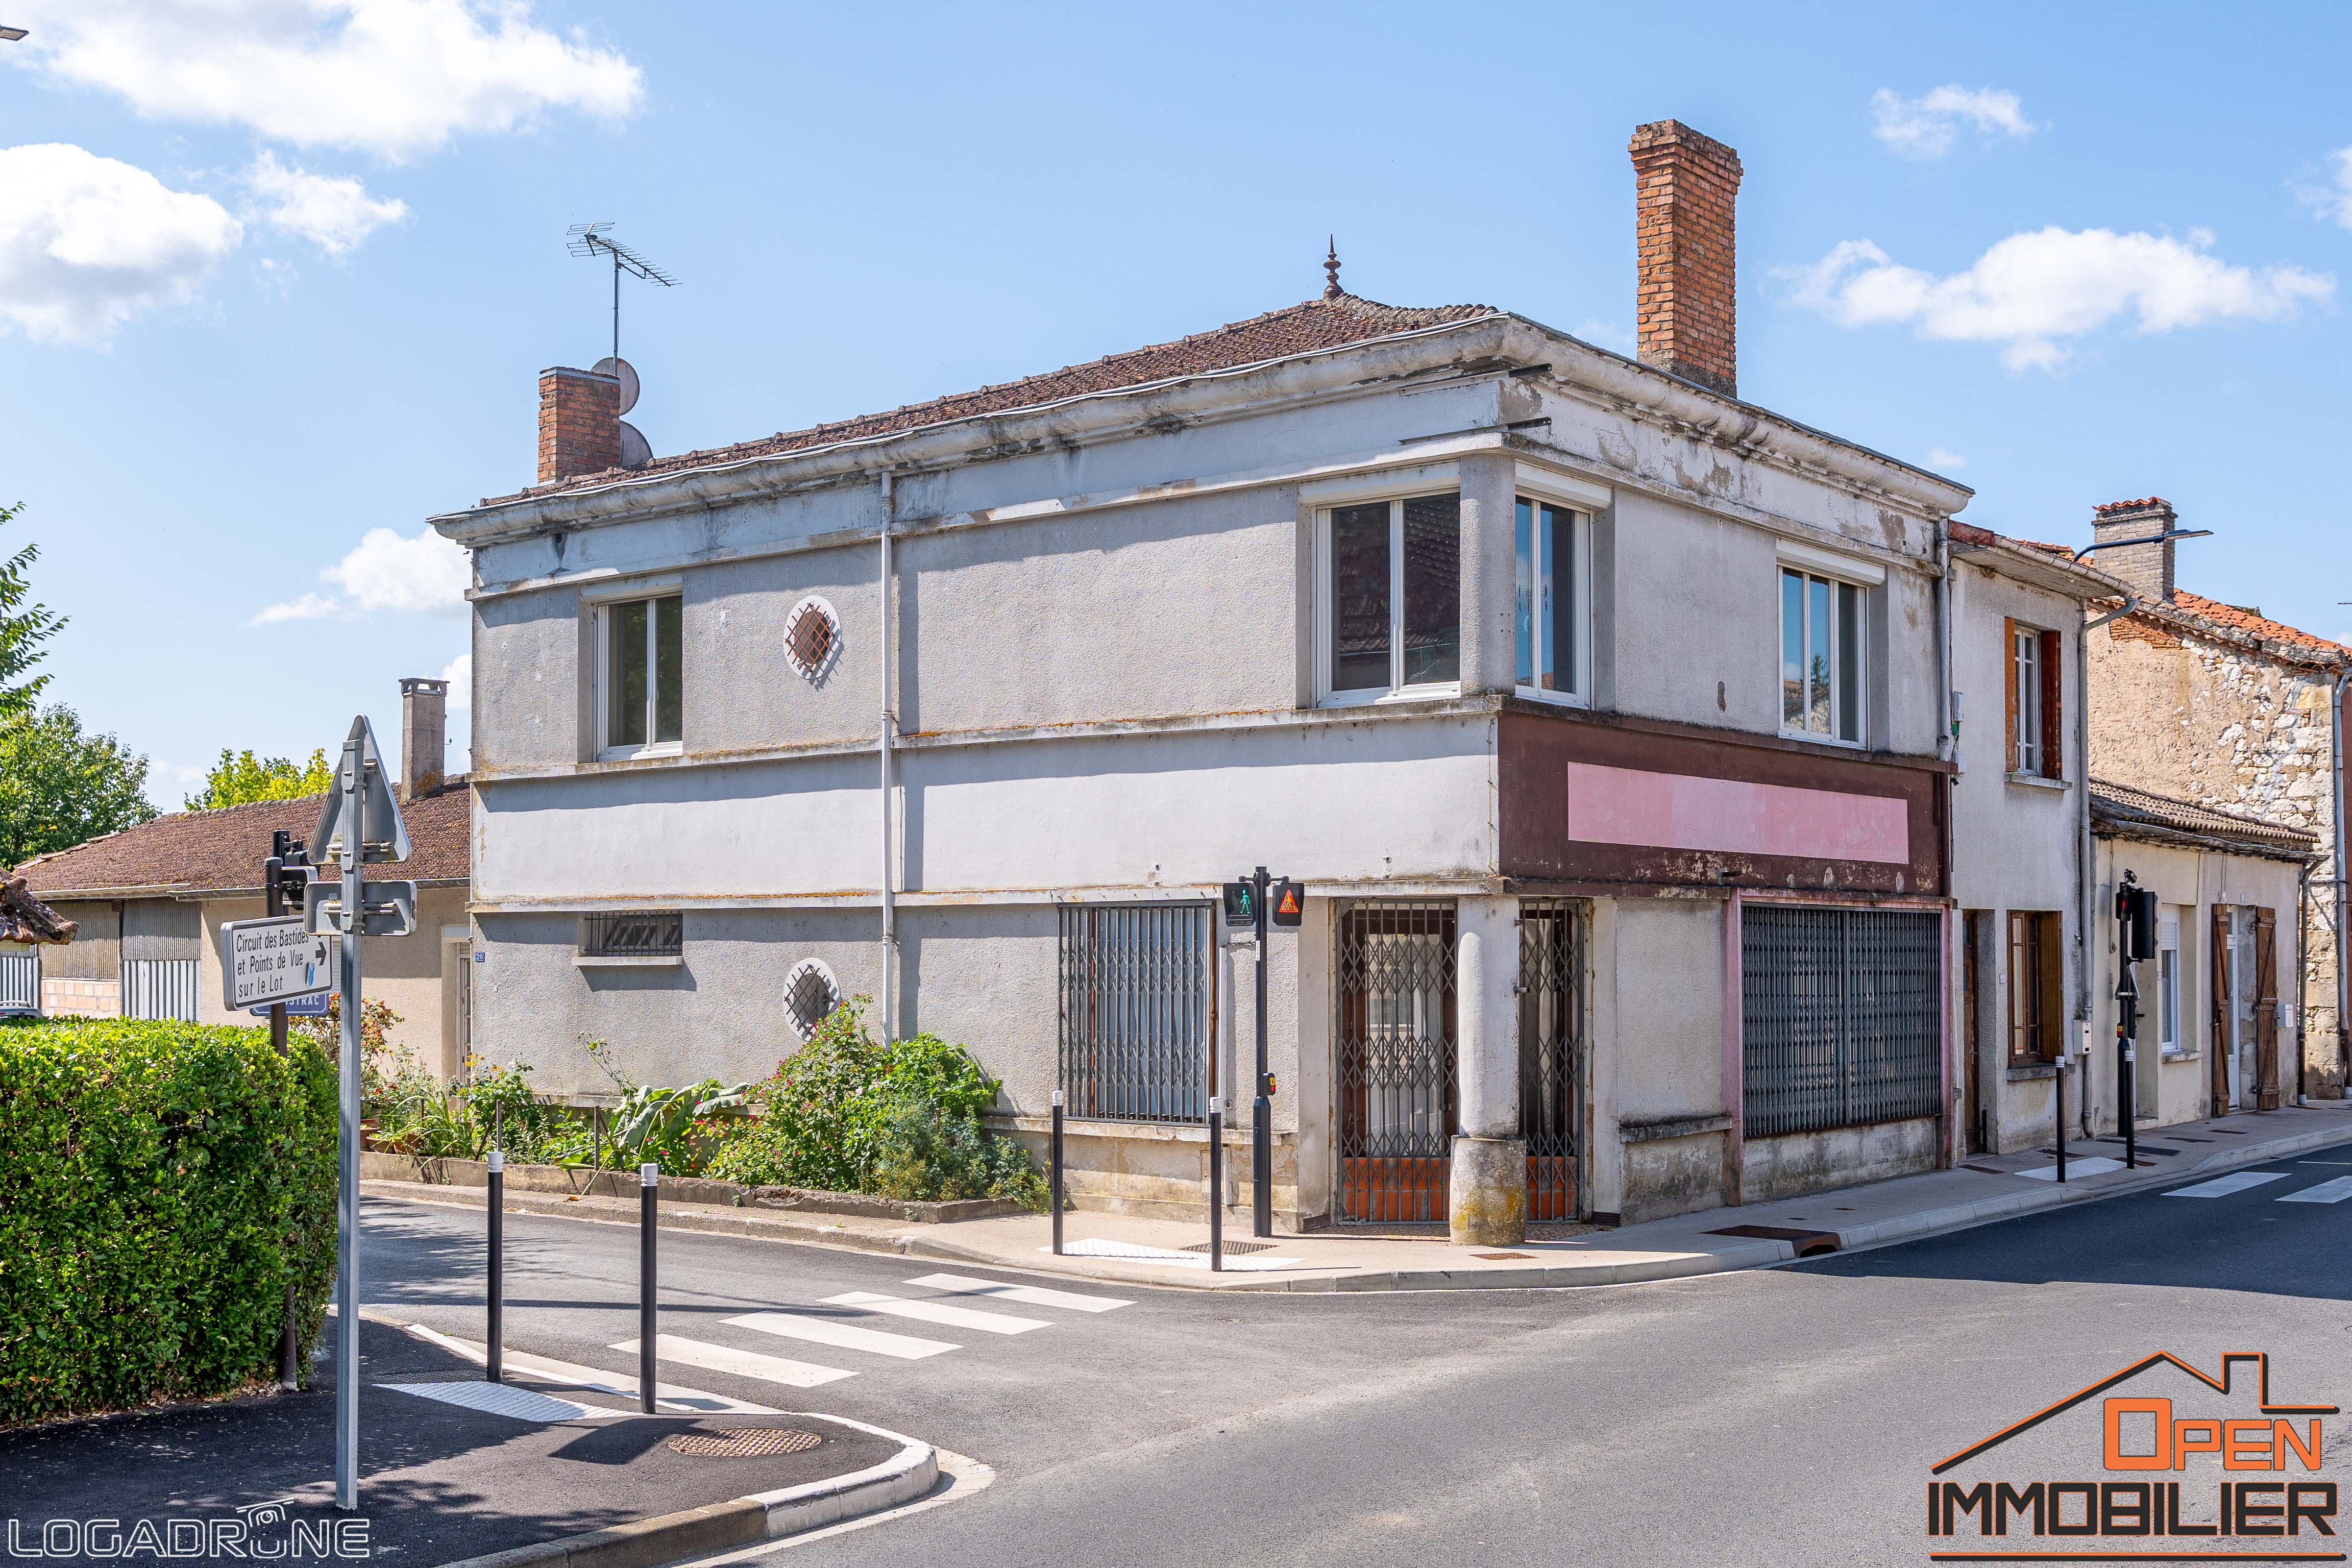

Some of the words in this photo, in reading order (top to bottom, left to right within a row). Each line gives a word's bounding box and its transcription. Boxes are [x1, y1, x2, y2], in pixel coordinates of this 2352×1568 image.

[237, 932, 262, 952] Circuit
[264, 931, 277, 949] des
[279, 927, 309, 947] Bastides
[238, 959, 246, 975] et
[250, 954, 273, 973] Points
[277, 951, 285, 969] de
[290, 949, 303, 966] Vue
[239, 983, 253, 997] sur
[258, 976, 265, 994] le
[270, 974, 283, 992] Lot
